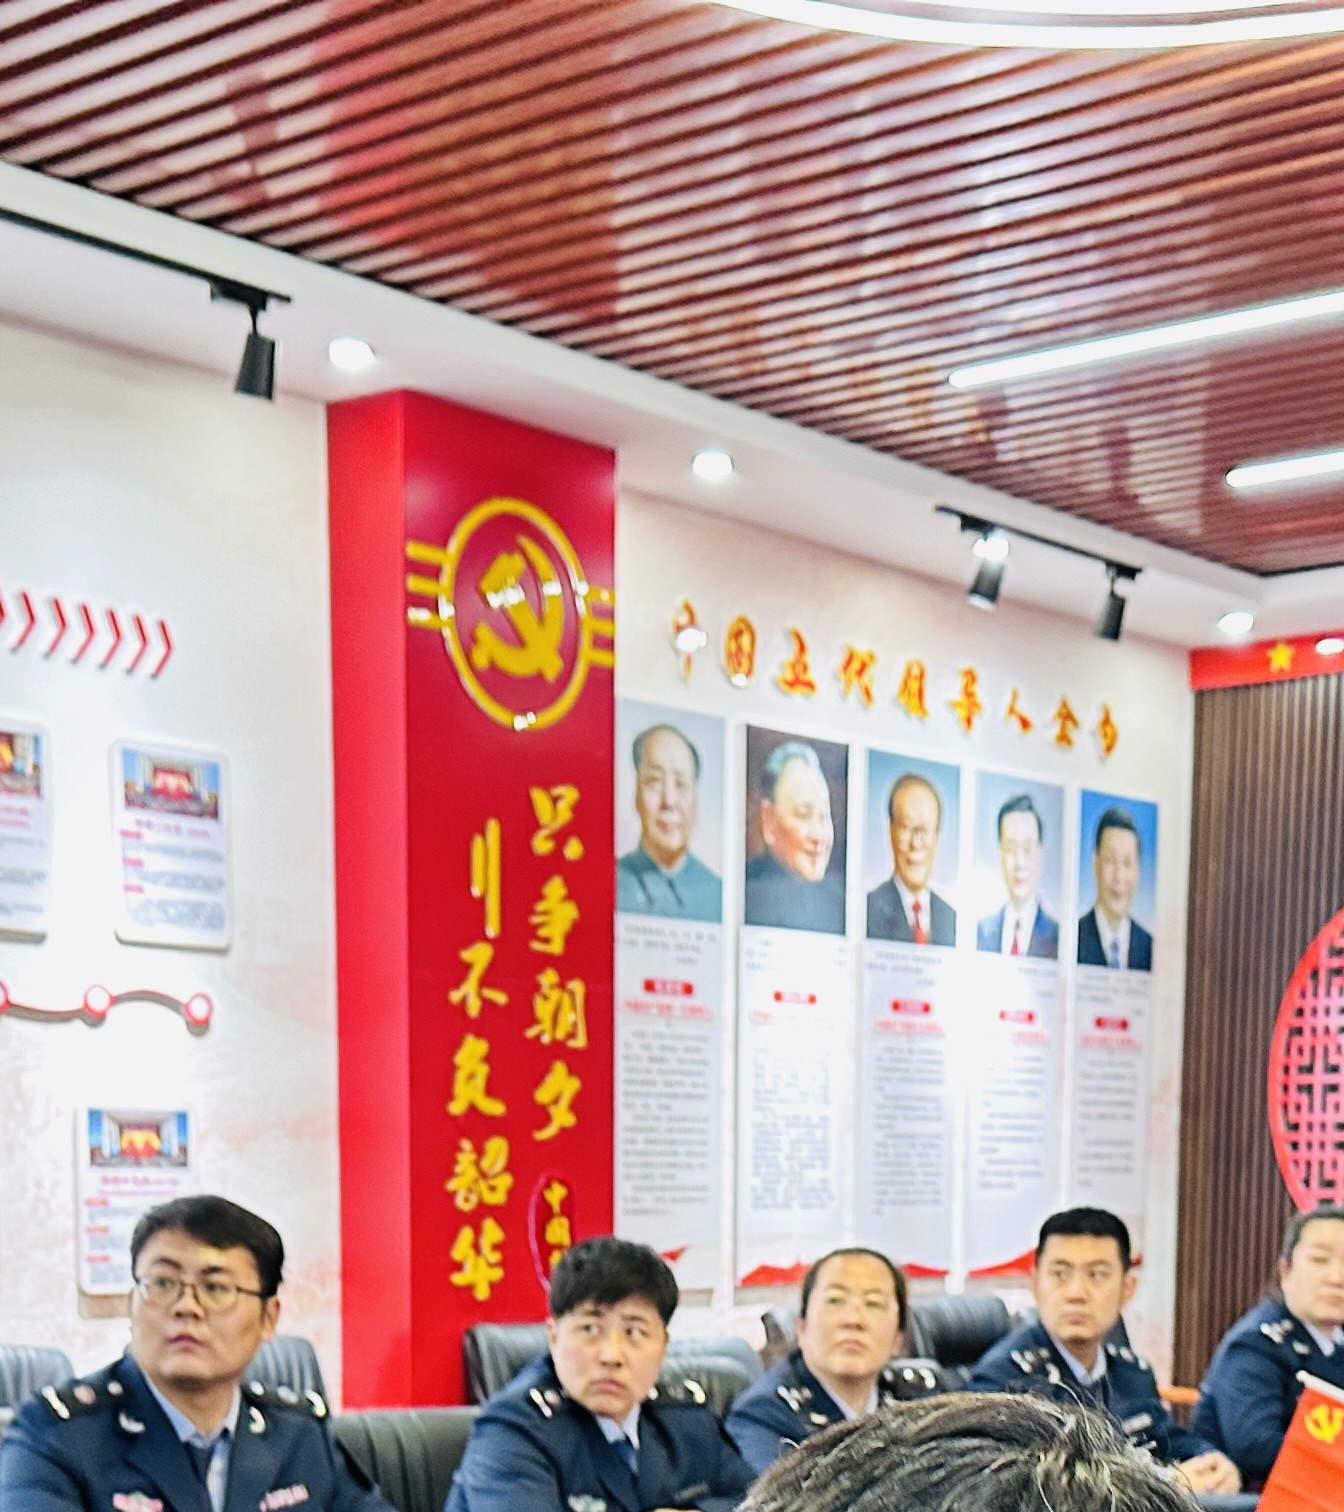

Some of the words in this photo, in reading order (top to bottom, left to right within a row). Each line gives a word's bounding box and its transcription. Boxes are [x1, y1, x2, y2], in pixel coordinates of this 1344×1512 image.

[445, 941, 515, 1302] 不负韶华
[523, 784, 588, 1141] 只争朝夕
[543, 1180, 572, 1267] 中国
